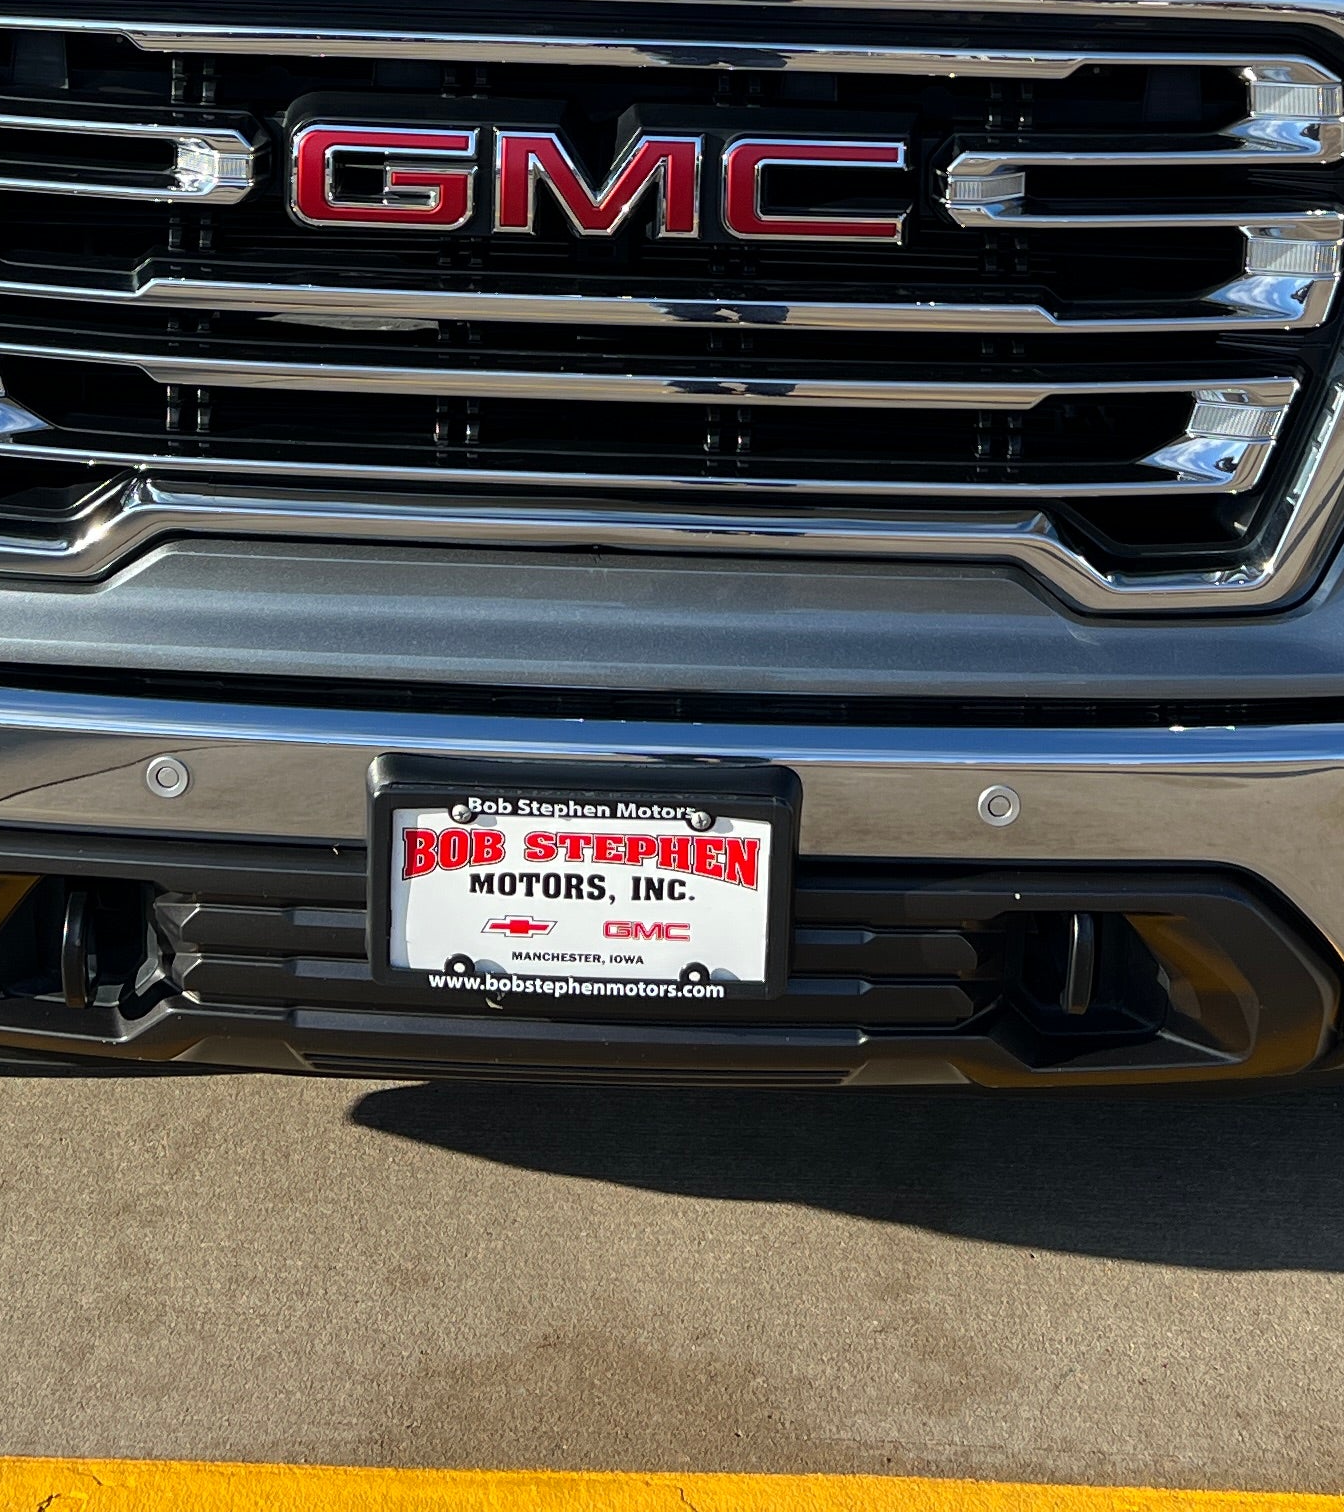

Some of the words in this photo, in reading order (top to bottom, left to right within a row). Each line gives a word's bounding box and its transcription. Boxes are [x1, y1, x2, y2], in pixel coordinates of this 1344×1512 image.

[290, 124, 910, 246] GMC
[468, 797, 513, 815] Bob
[517, 799, 610, 819] Stephen
[616, 802, 696, 819] Motors
[402, 827, 506, 881] BOB
[523, 831, 761, 891] STEPHEN
[469, 872, 616, 905] MOTORS,
[630, 875, 696, 902] INC.
[602, 920, 691, 942] GMC
[511, 951, 606, 965] MANCHESTER,
[609, 954, 645, 966] IOWA
[428, 971, 725, 999] www.bobstephenmotors.com
